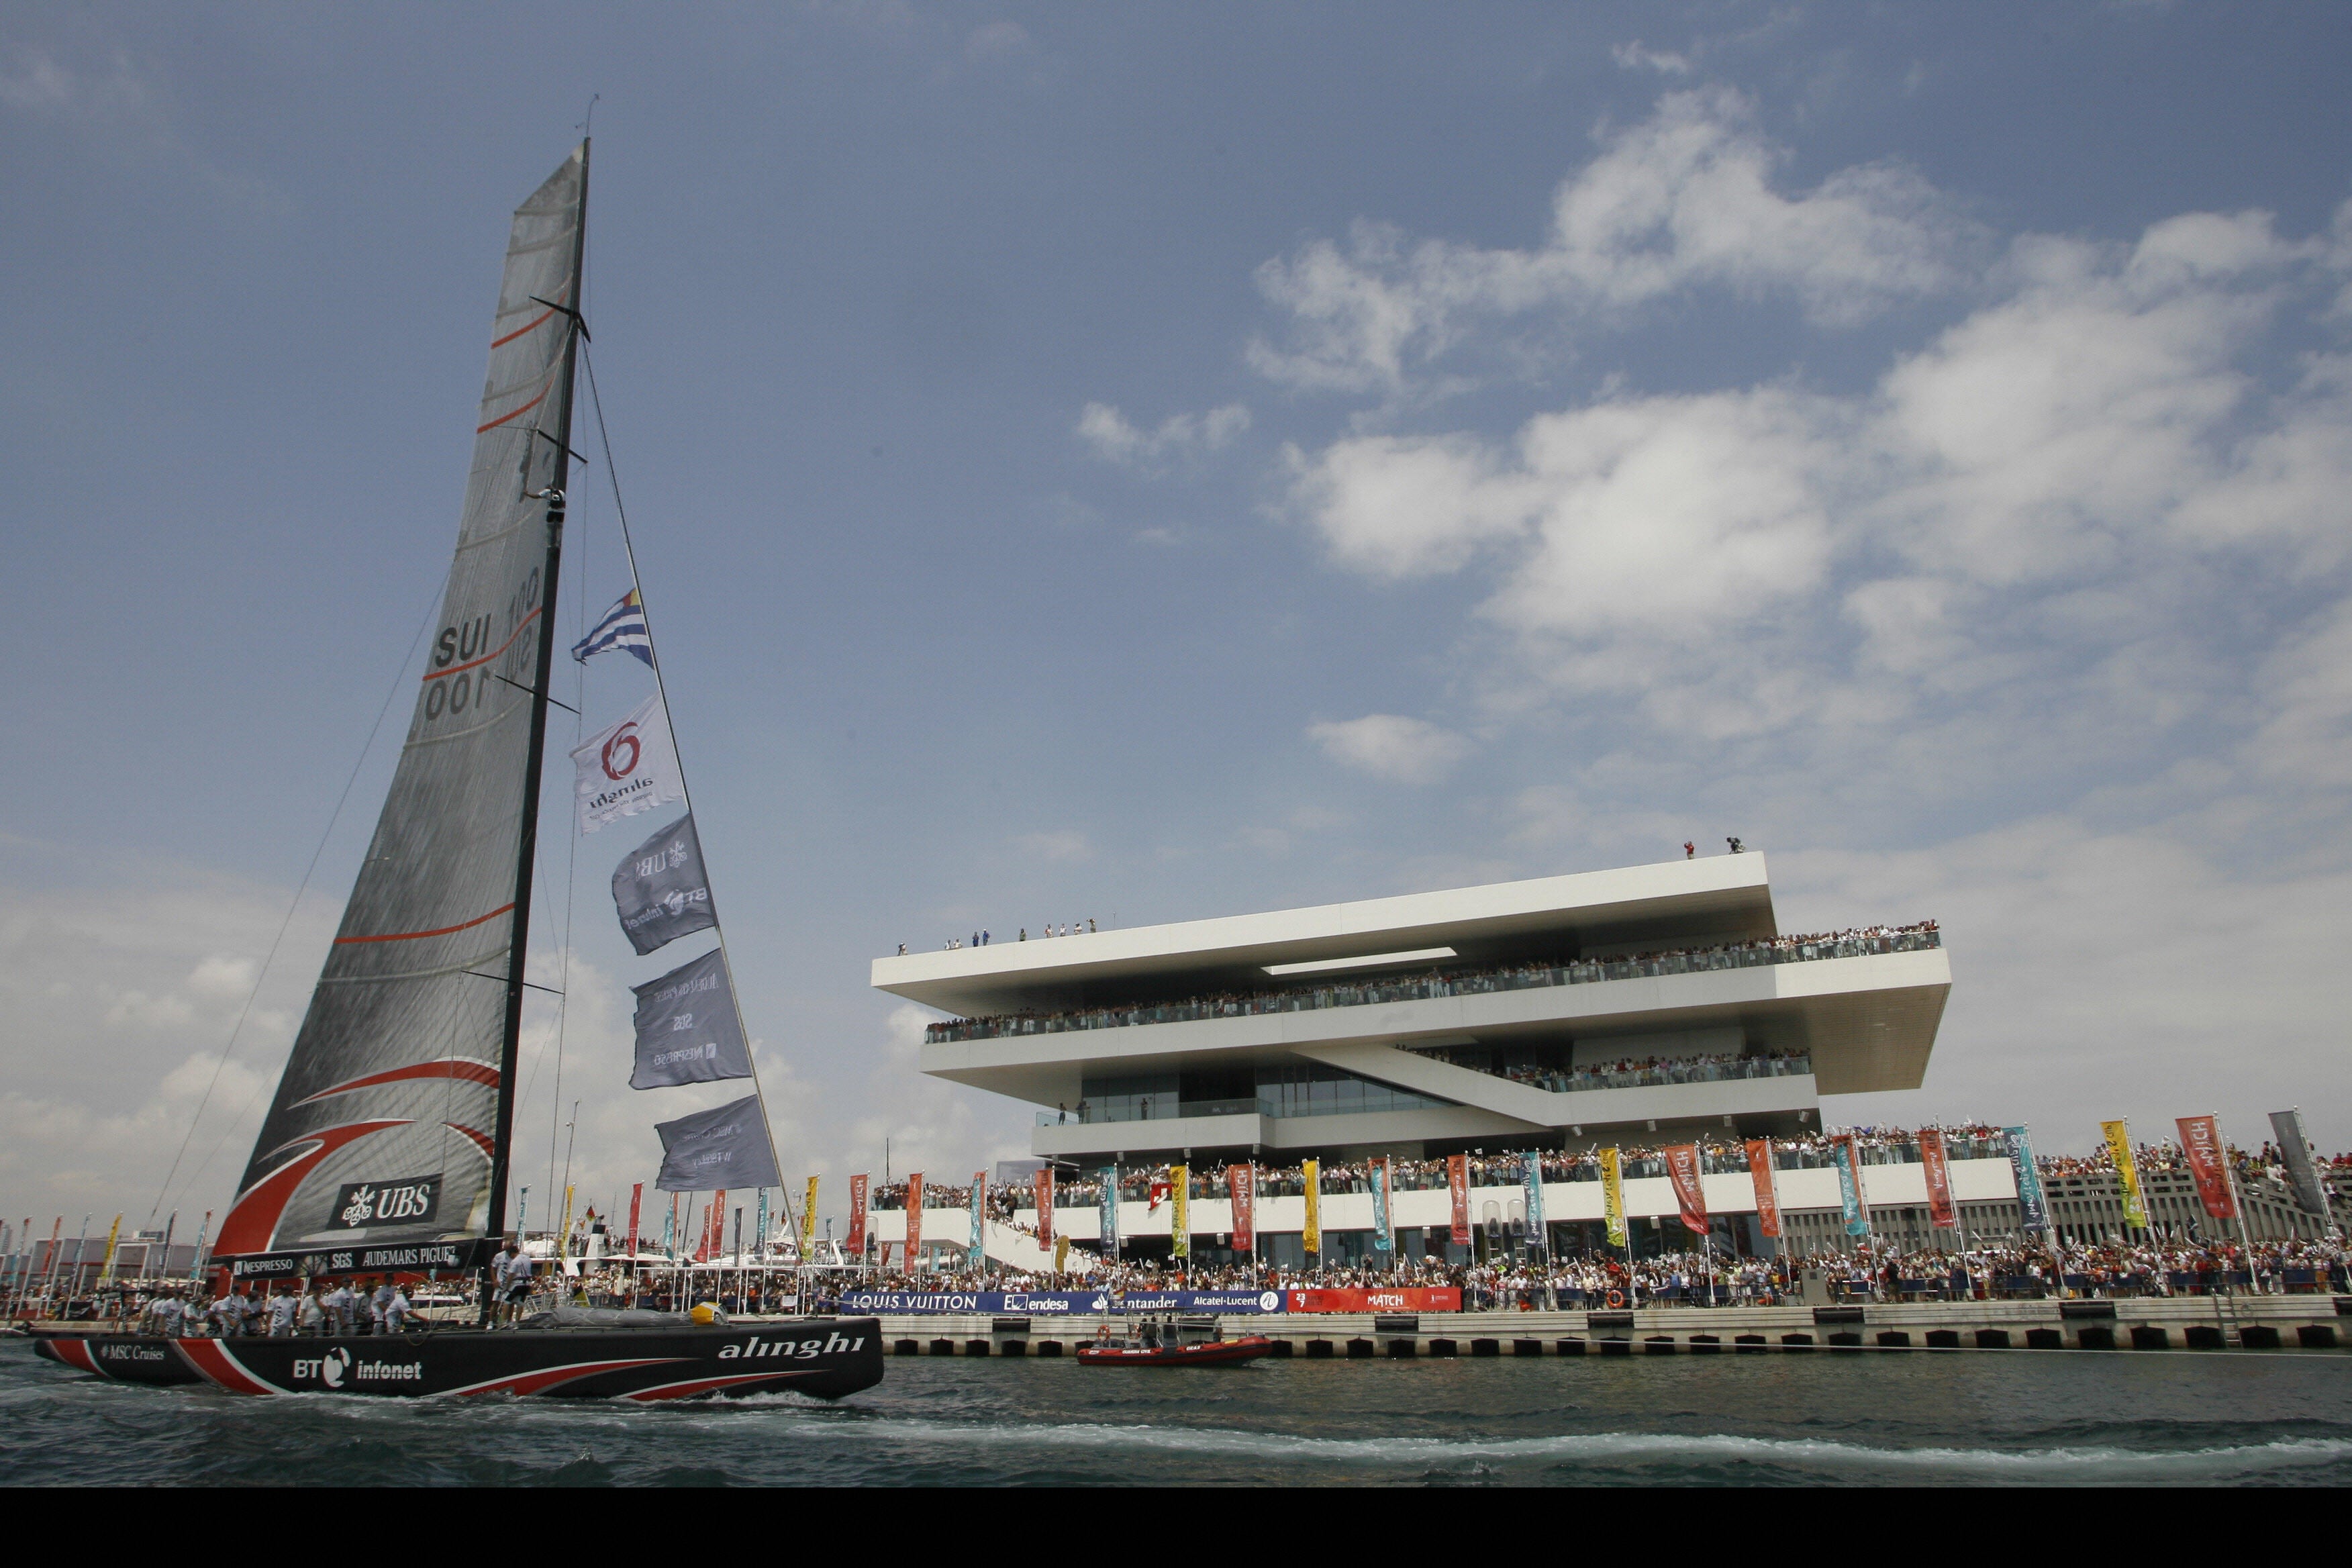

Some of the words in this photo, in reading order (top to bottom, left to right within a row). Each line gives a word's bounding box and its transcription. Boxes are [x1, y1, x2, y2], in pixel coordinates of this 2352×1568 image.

[436, 613, 492, 667] SUI
[377, 1184, 430, 1219] UBS
[243, 1259, 293, 1274] NESPRESSO
[332, 1252, 352, 1269] SGS
[362, 1249, 418, 1267] AUDEMARS
[853, 1295, 899, 1310] LOUIS
[906, 1295, 977, 1310] VUITTON
[1029, 1298, 1069, 1310] endesa
[1112, 1295, 1177, 1309] ntander
[1296, 1293, 1306, 1301] 23
[1367, 1294, 1404, 1308] MATCH
[109, 1344, 132, 1359] MSC
[133, 1344, 165, 1361] Cruises
[718, 1332, 865, 1359] alinghi
[293, 1359, 322, 1378] BT
[357, 1360, 422, 1380] infonet
